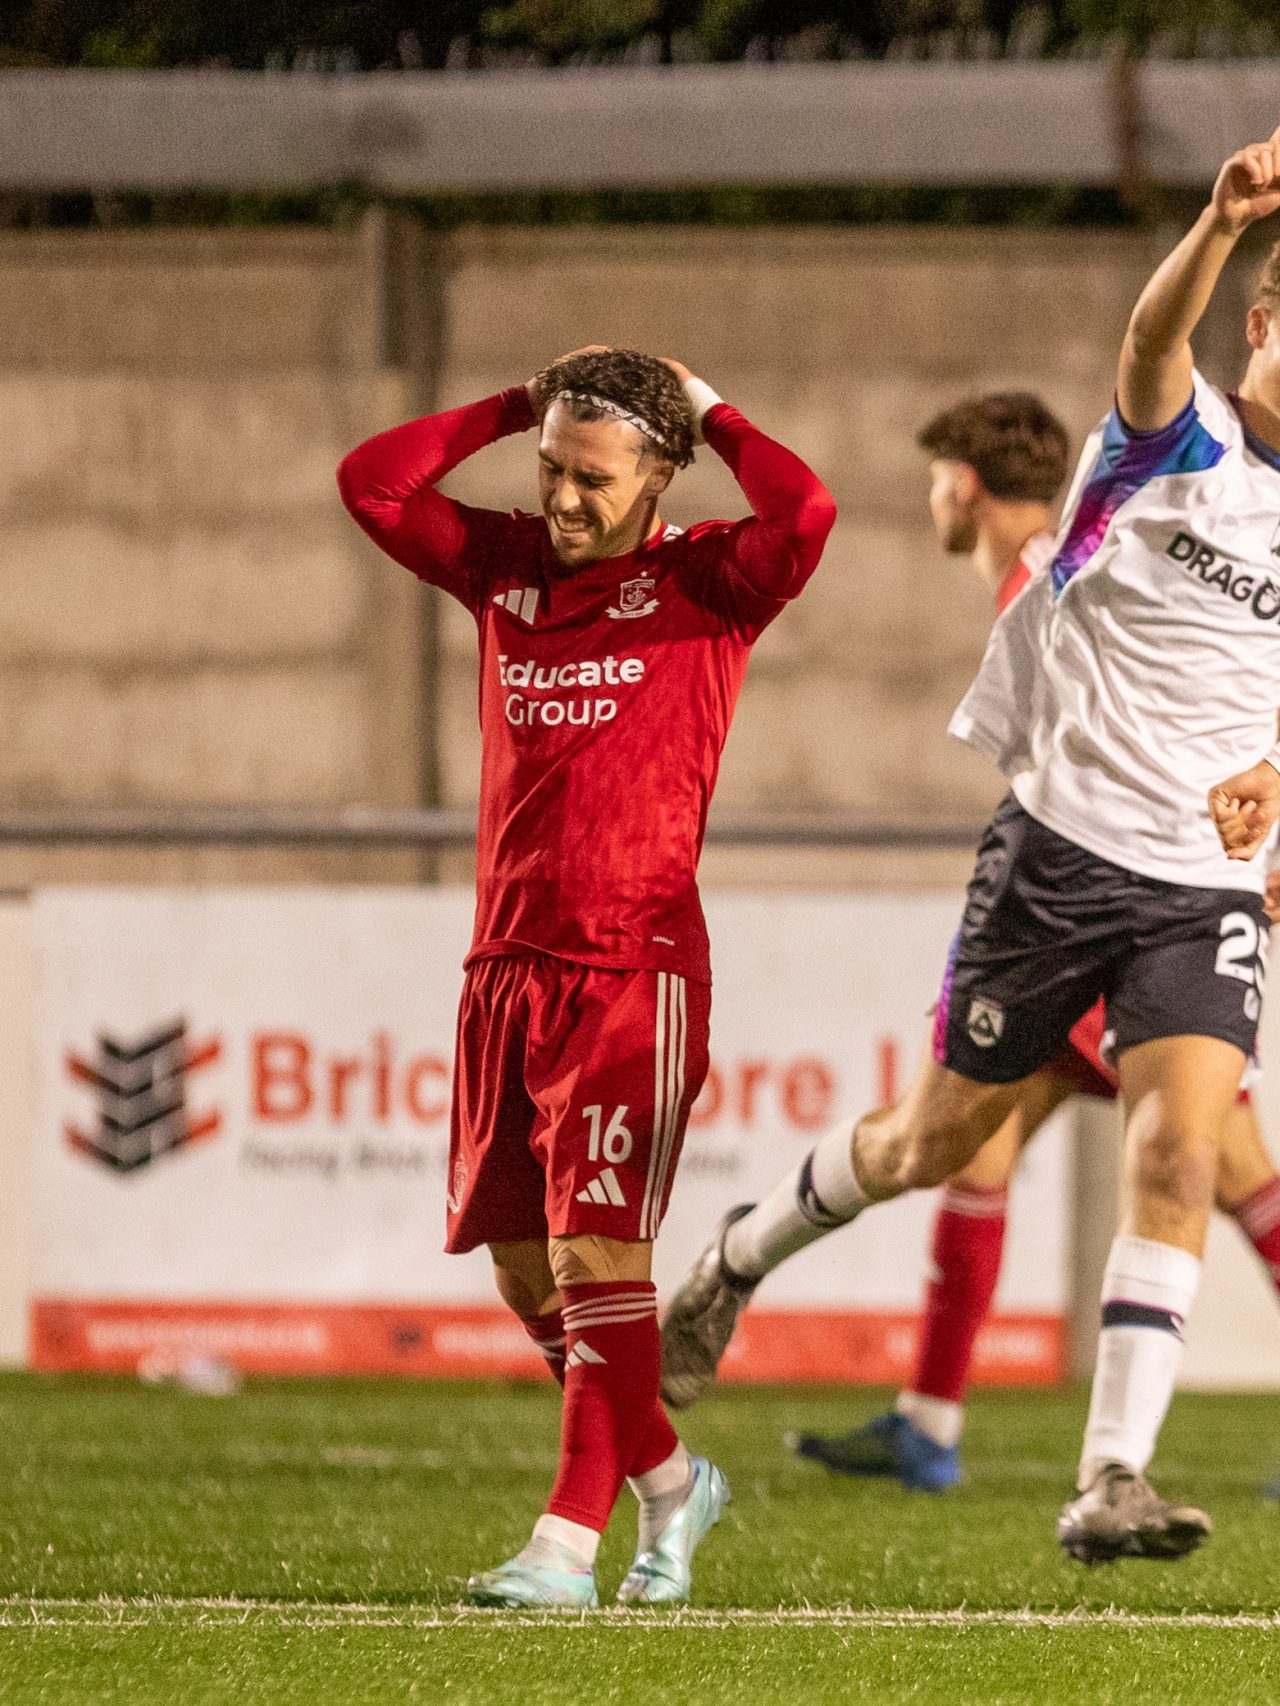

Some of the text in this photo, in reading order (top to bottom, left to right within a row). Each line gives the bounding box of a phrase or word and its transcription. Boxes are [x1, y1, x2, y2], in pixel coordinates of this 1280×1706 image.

[497, 654, 646, 689] Educate
[505, 693, 618, 729] Group
[251, 1030, 450, 1127] Bric
[582, 1104, 633, 1164] 16
